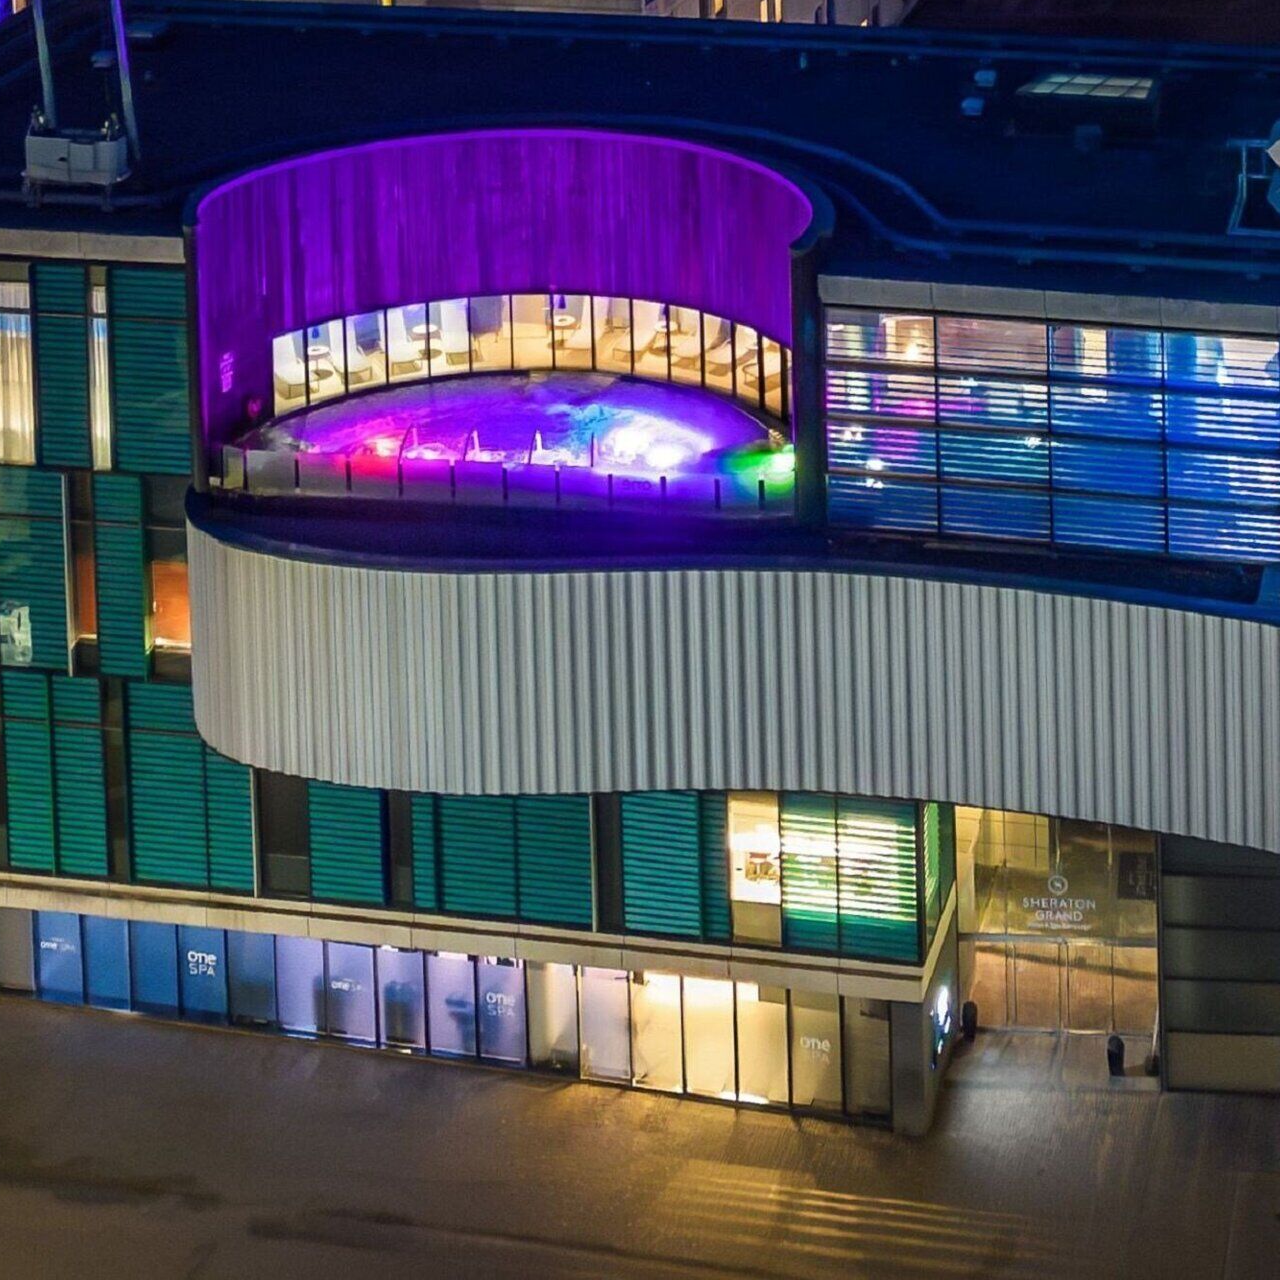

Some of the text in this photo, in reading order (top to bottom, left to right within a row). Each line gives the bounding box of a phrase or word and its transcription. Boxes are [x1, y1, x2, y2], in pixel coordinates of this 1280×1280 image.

[1022, 897, 1096, 910] SHERATON
[1035, 910, 1083, 922] GRAND
[187, 951, 217, 965] one
[189, 963, 216, 977] SPA
[486, 992, 516, 1007] one
[487, 1004, 516, 1017] SPA
[800, 1037, 831, 1052] one
